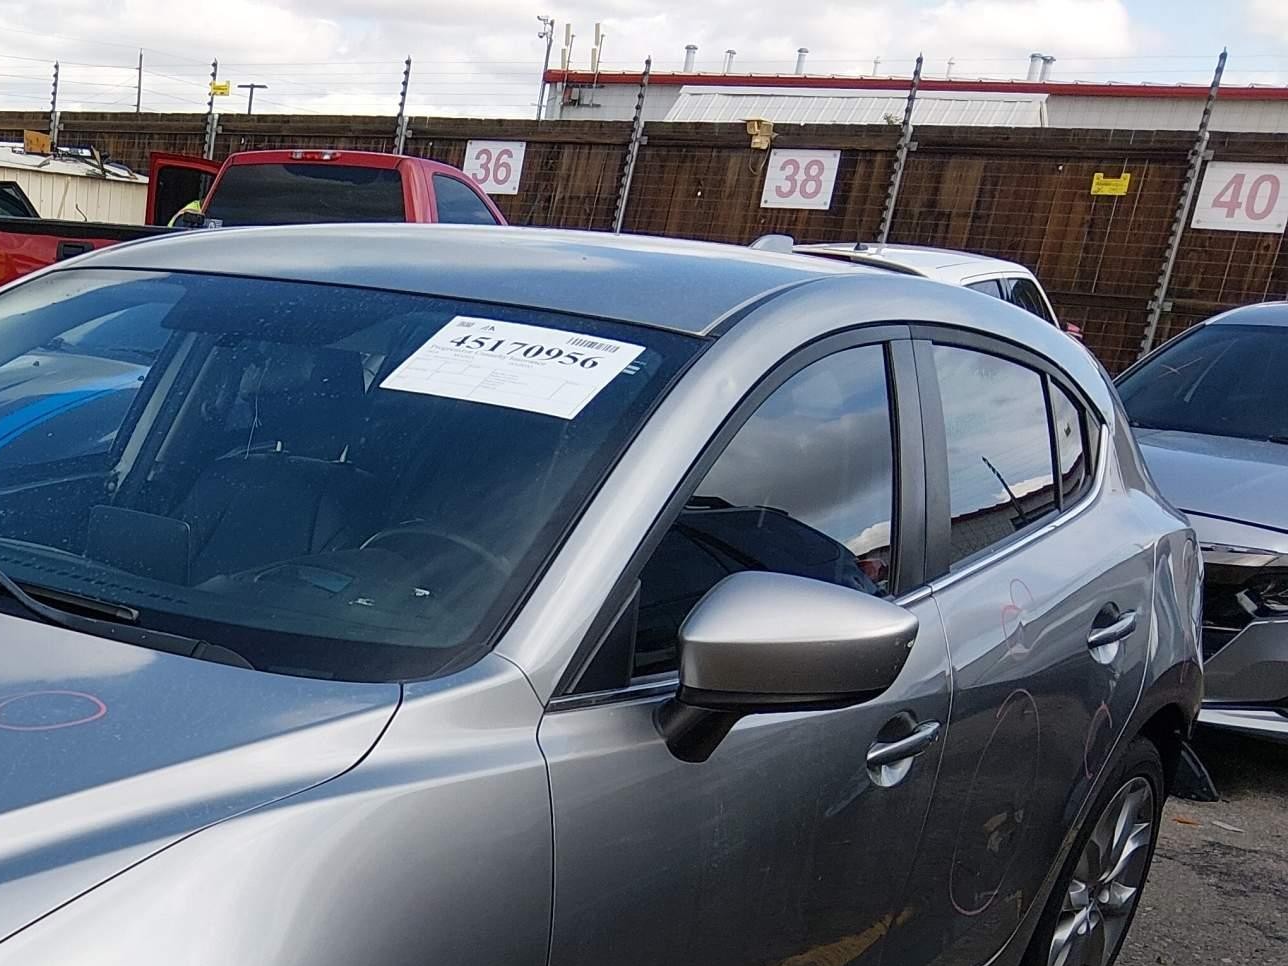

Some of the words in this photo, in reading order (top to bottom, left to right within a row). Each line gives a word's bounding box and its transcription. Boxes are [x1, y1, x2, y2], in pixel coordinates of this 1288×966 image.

[472, 148, 513, 185] 36
[775, 158, 825, 199] 38
[1211, 173, 1281, 220] 40
[450, 334, 605, 369] 45170956
